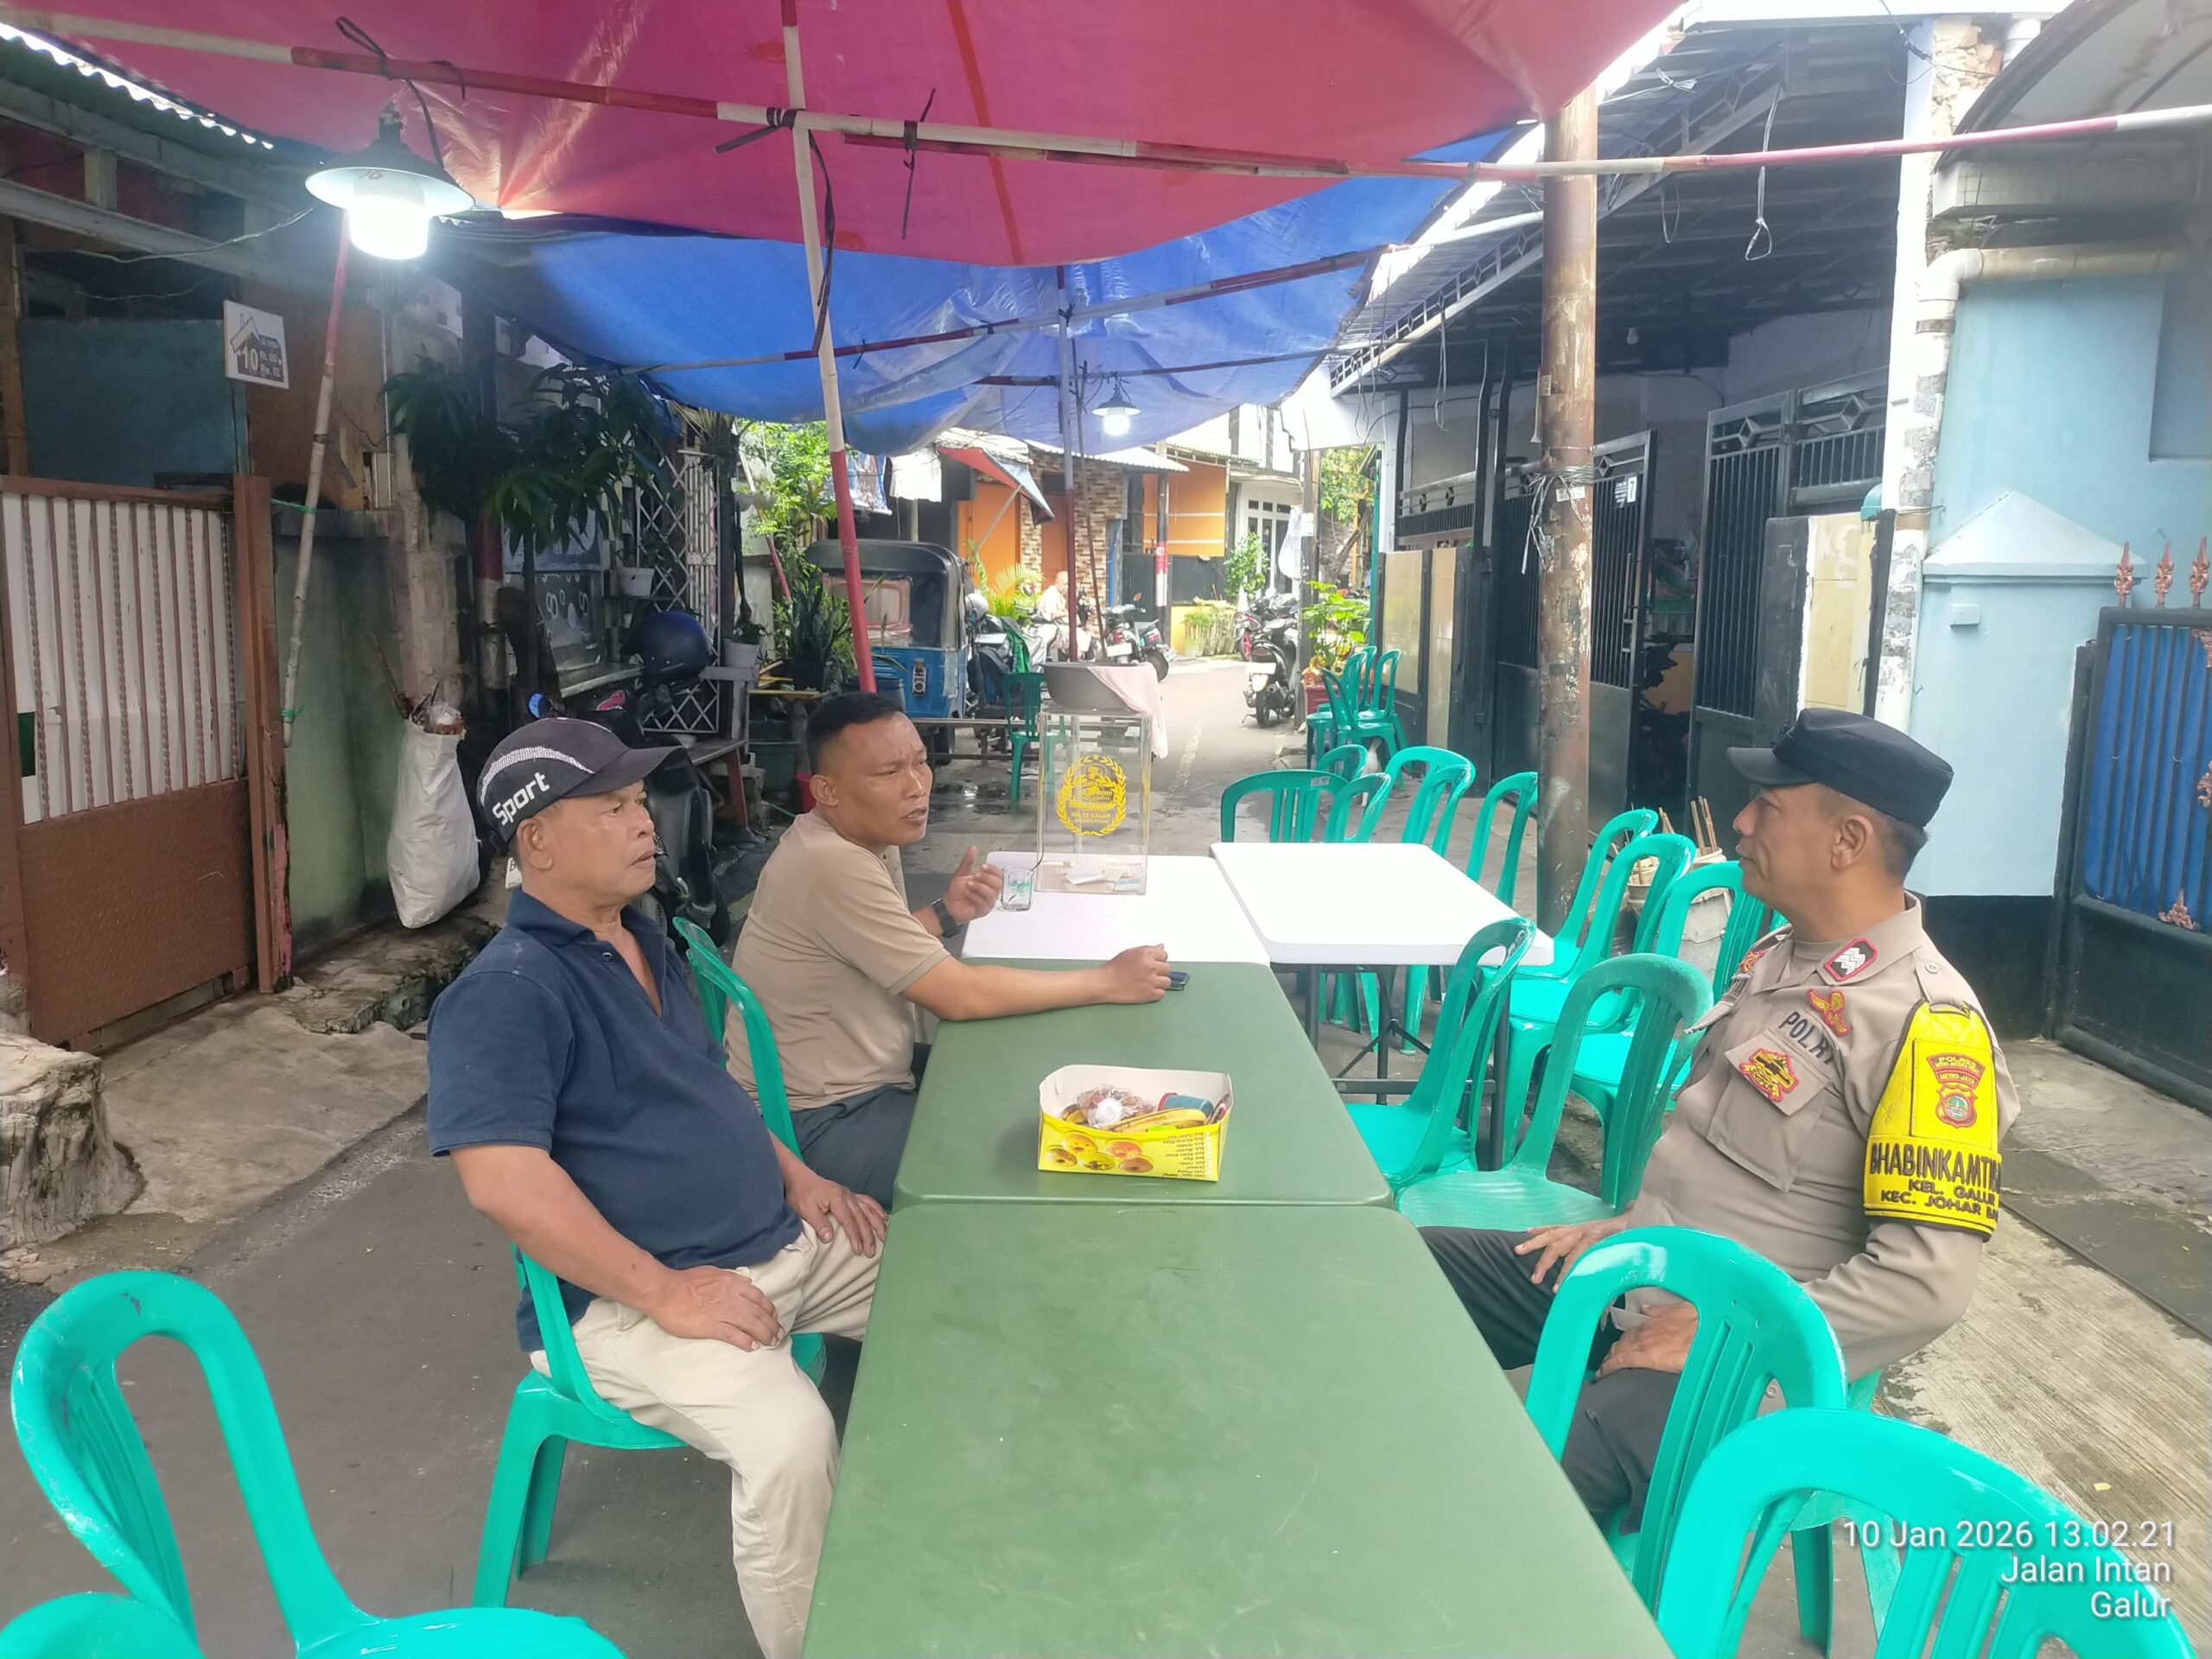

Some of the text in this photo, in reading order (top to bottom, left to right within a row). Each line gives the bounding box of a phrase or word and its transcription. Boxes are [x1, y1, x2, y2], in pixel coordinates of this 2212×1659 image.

[242, 345, 258, 372] 10
[492, 772, 550, 826] Sport
[1751, 1069, 1774, 1090] SNIPER
[1881, 1190, 1916, 1205] KEC.
[1924, 1196, 1981, 1216] JOHAR
[1909, 1179, 1996, 1205] KEL. GALUR
